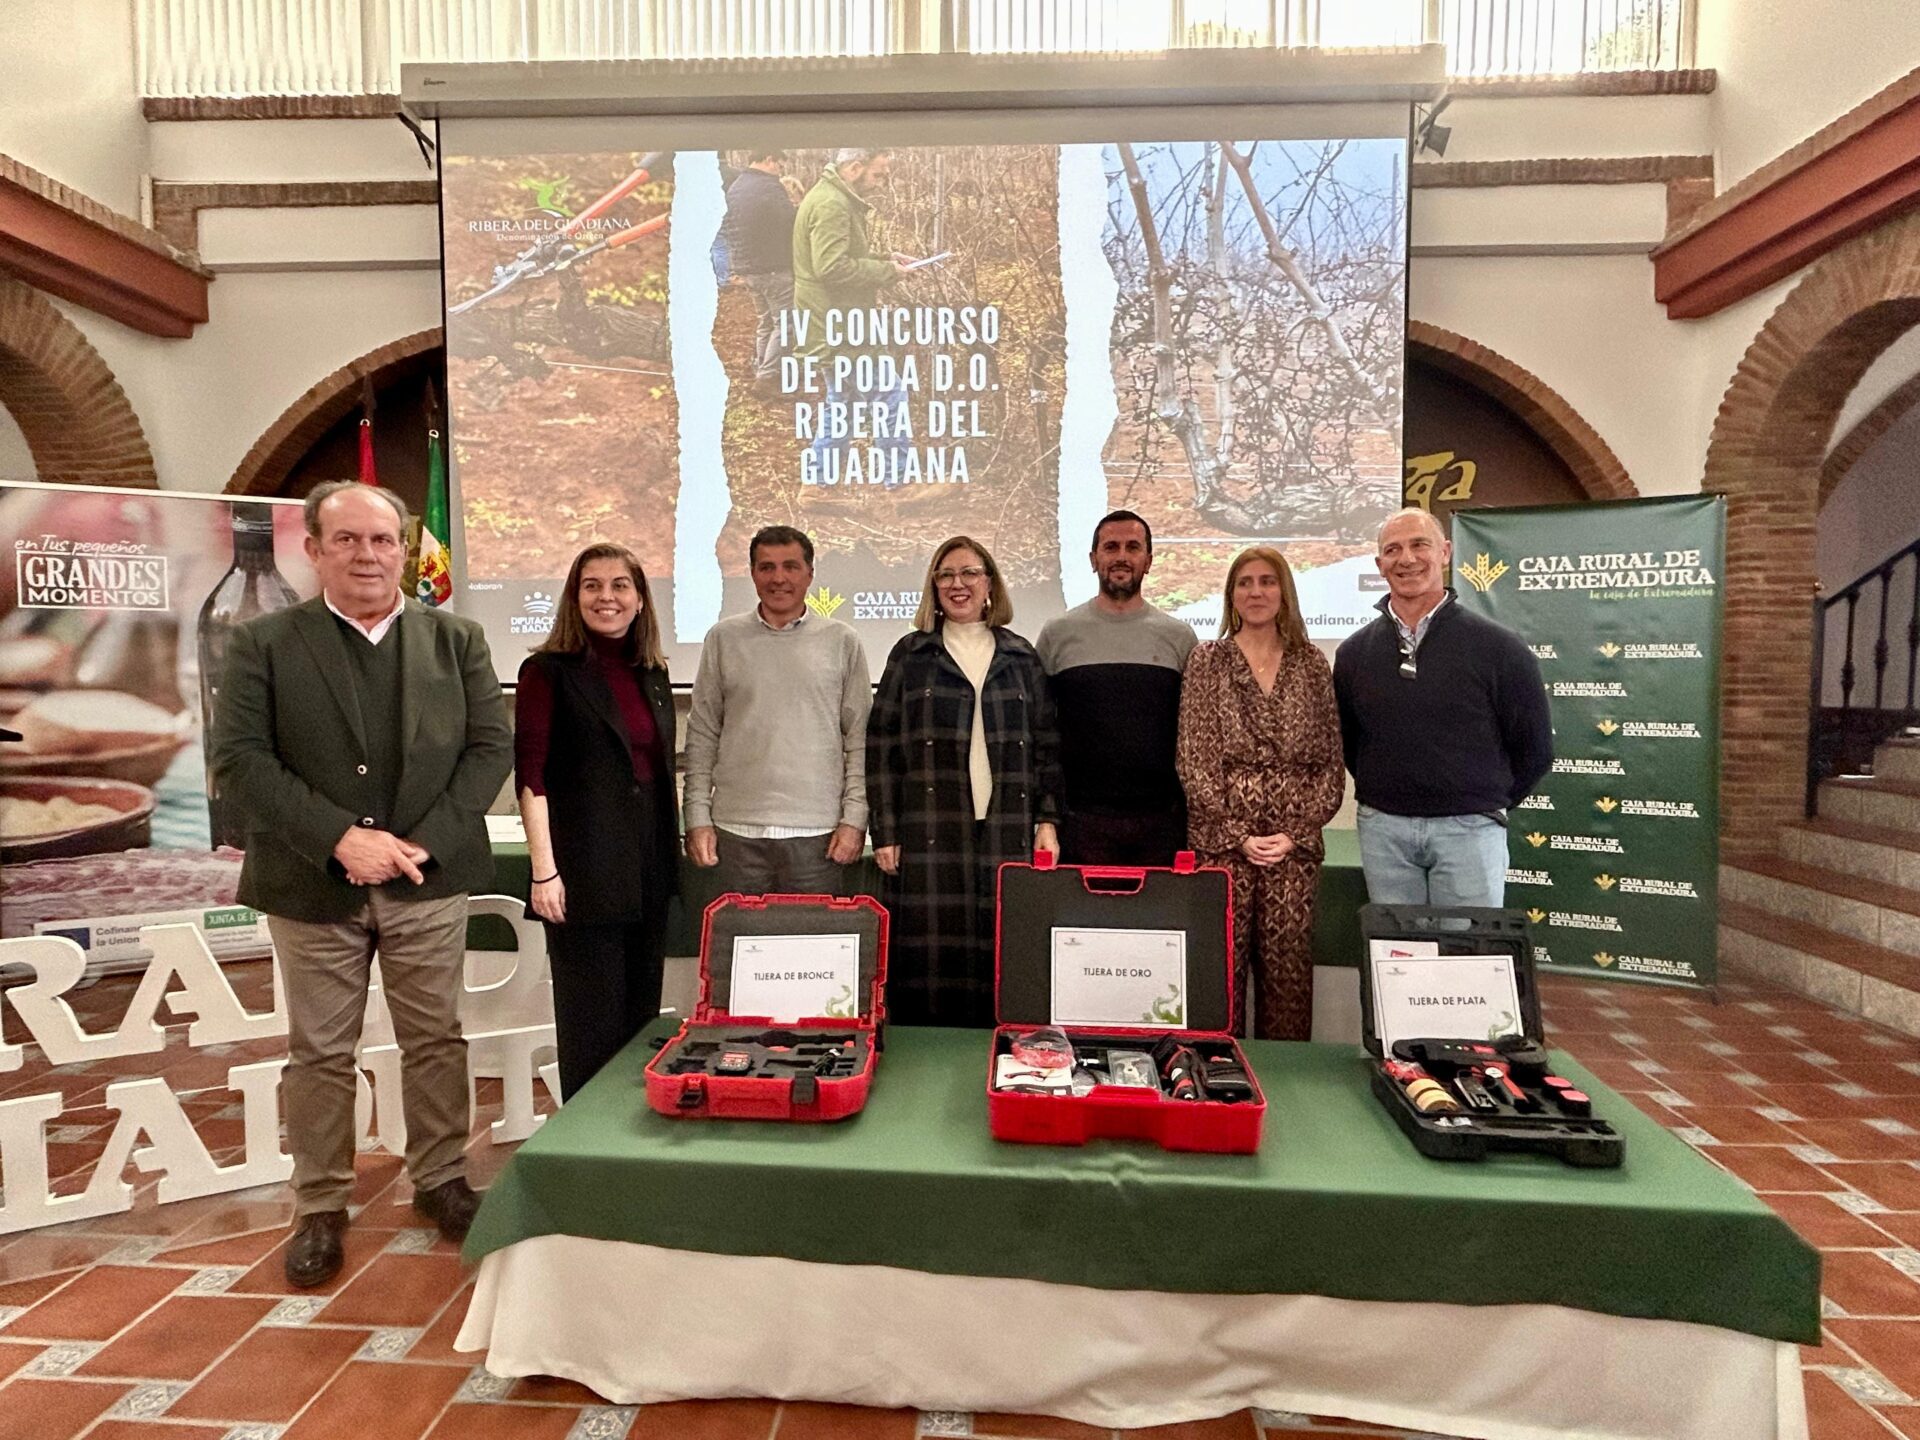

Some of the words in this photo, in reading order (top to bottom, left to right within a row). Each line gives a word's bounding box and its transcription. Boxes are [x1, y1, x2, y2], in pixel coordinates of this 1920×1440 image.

[469, 220, 522, 232] RIBERA
[524, 220, 552, 231] DEL
[555, 218, 632, 231] GUADIANA
[780, 309, 811, 347] IV
[826, 306, 998, 347] CONCURSO
[781, 356, 819, 394] DE
[835, 354, 920, 392] PODA
[935, 354, 999, 392] D.O.
[795, 401, 914, 440] RIBERA
[929, 400, 986, 438] DEL
[801, 446, 970, 485] GUADIANA
[15, 539, 38, 550] en
[41, 534, 69, 551] Tus
[72, 540, 147, 556] pequeños
[1518, 556, 1574, 574] CAJA
[1578, 552, 1660, 572] RURAL
[1664, 550, 1700, 568] DE
[25, 556, 161, 590] GRANDES
[1518, 568, 1716, 591] EXTREMADURA
[28, 587, 160, 605] MOMENTOS
[854, 592, 897, 606] CAJA
[854, 606, 919, 619] EXTRE
[208, 914, 236, 924] JUNTA
[754, 972, 782, 980] TIJERA
[784, 972, 795, 980] DE
[798, 971, 834, 980] BRONCE
[1084, 968, 1113, 976] TIJERA
[1116, 968, 1128, 976] DE
[1130, 968, 1152, 978] ORO
[1408, 996, 1440, 1006] TIJERA
[1443, 996, 1454, 1005] DE
[1458, 996, 1486, 1006] PLATA
